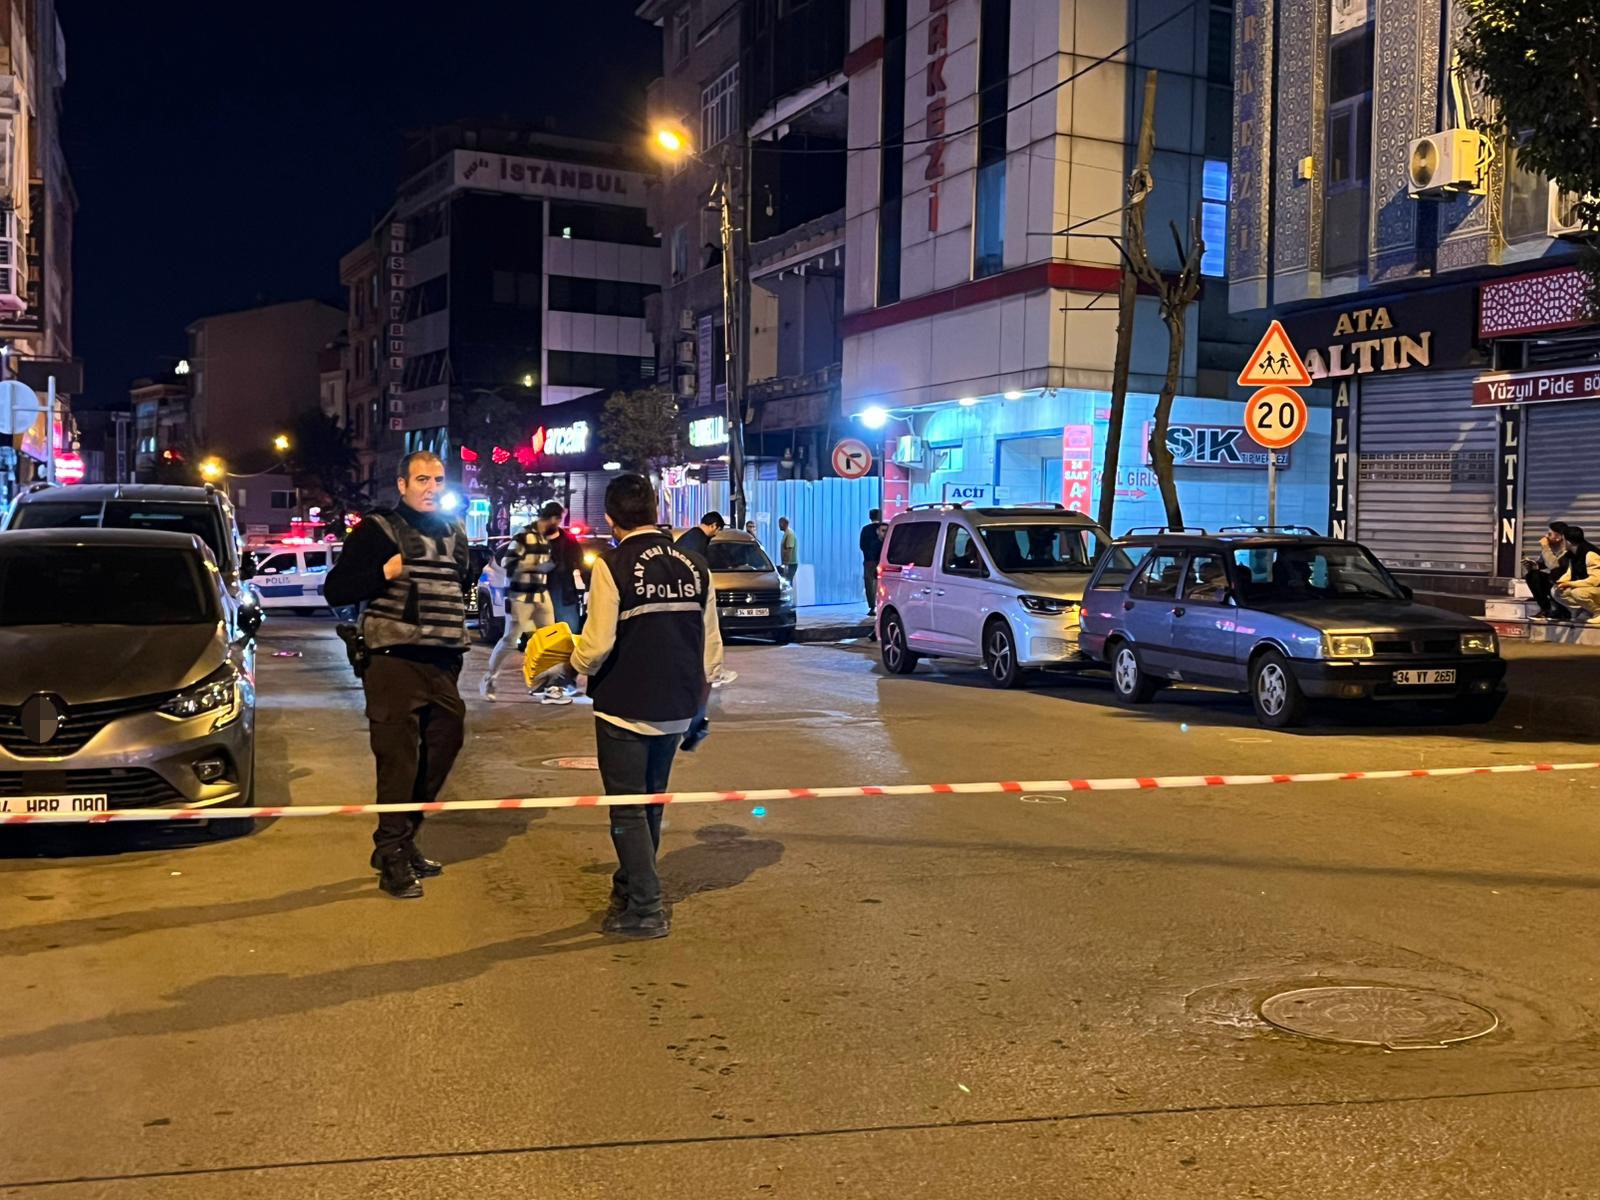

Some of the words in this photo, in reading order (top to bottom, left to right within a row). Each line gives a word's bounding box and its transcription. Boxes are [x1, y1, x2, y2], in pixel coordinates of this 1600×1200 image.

[925, 0, 948, 233] RKEZİ
[1333, 307, 1393, 336] ATA
[1304, 331, 1432, 380] ALTIN
[1488, 380, 1533, 402] Yüzyıl
[1538, 376, 1574, 396] Pide
[1257, 402, 1295, 429] 20
[1332, 381, 1349, 540] ALTIN
[1501, 404, 1521, 544] LTIN
[633, 562, 645, 595] OLAY
[645, 579, 696, 599] POLİS
